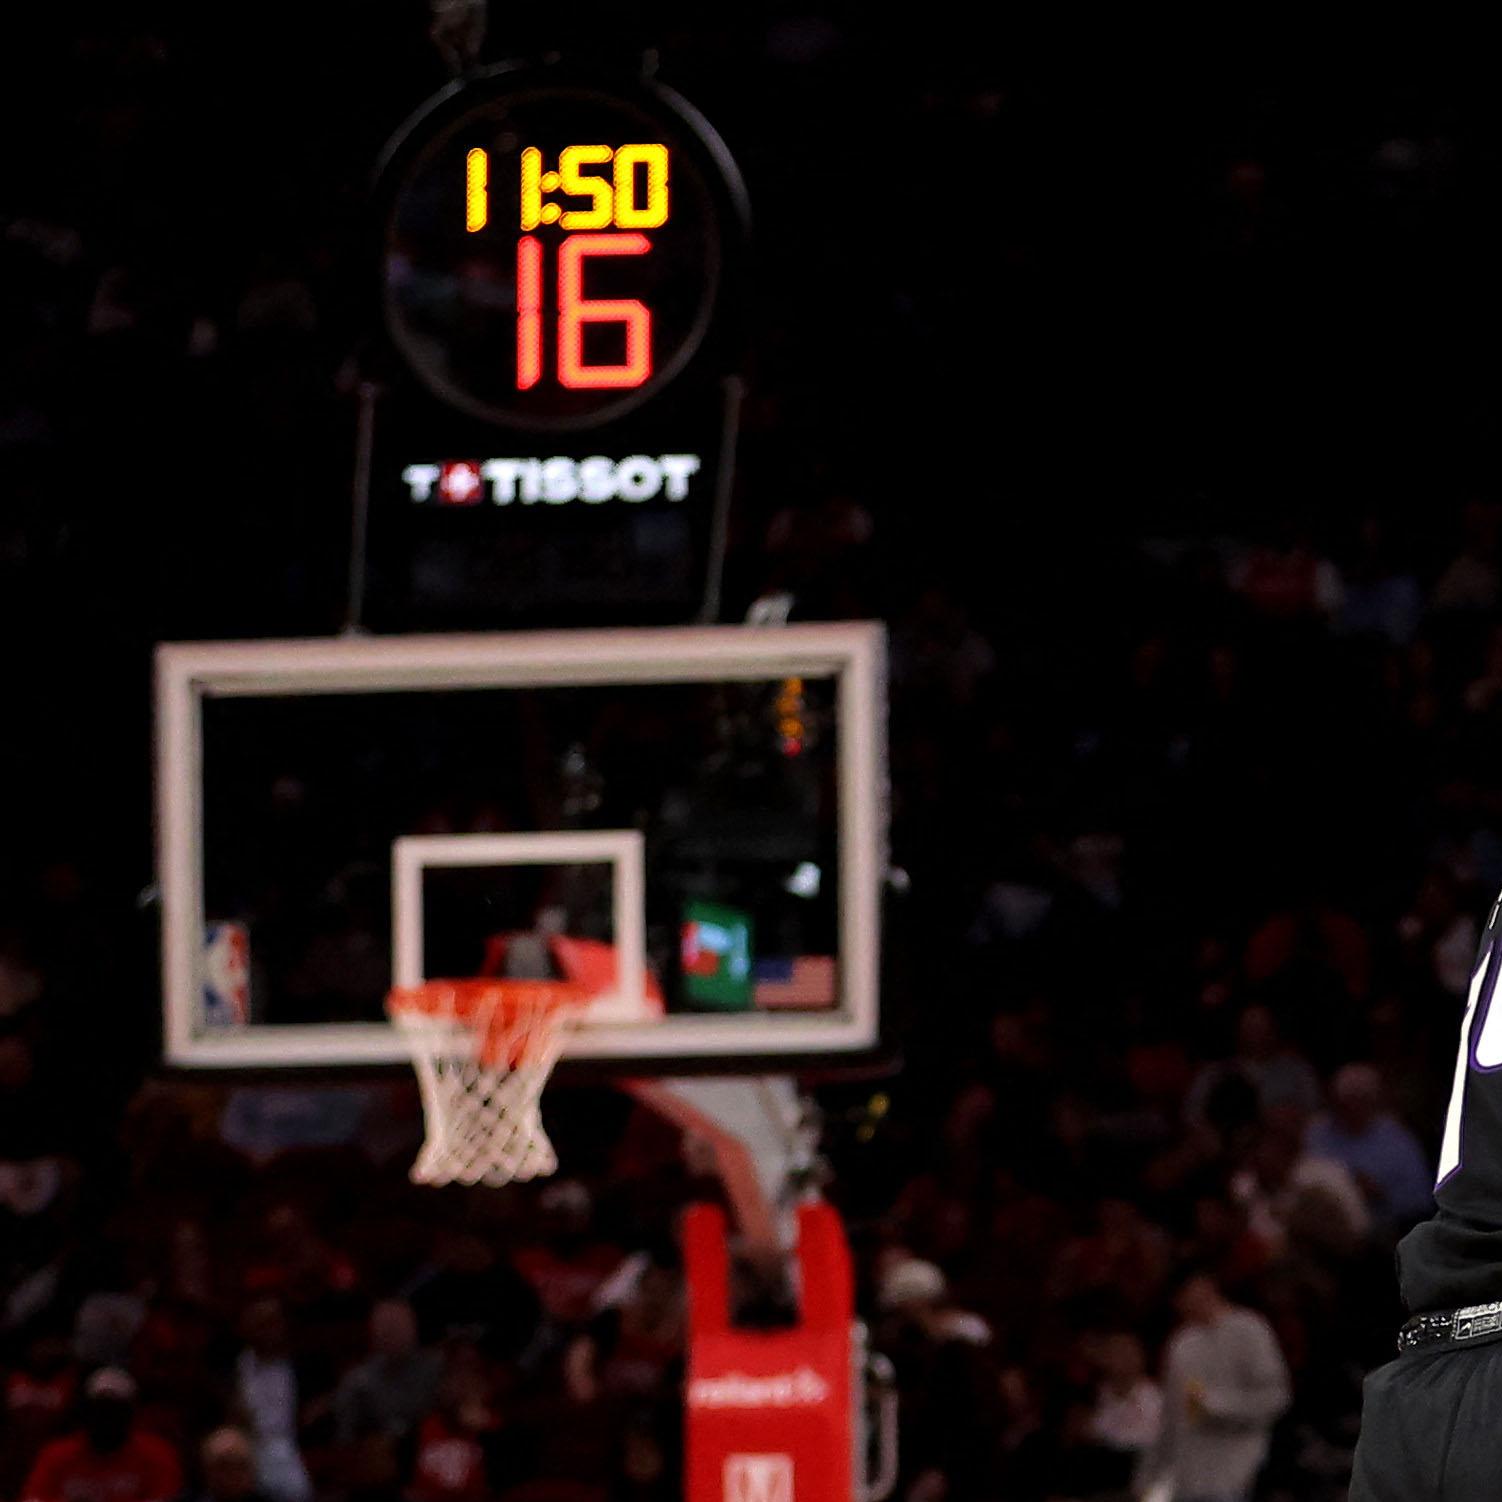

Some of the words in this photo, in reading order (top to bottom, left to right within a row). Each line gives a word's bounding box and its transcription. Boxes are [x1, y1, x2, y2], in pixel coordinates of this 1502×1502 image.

[466, 144, 669, 232] 11:50
[516, 234, 652, 391] 16
[484, 454, 700, 504] TISSOT
